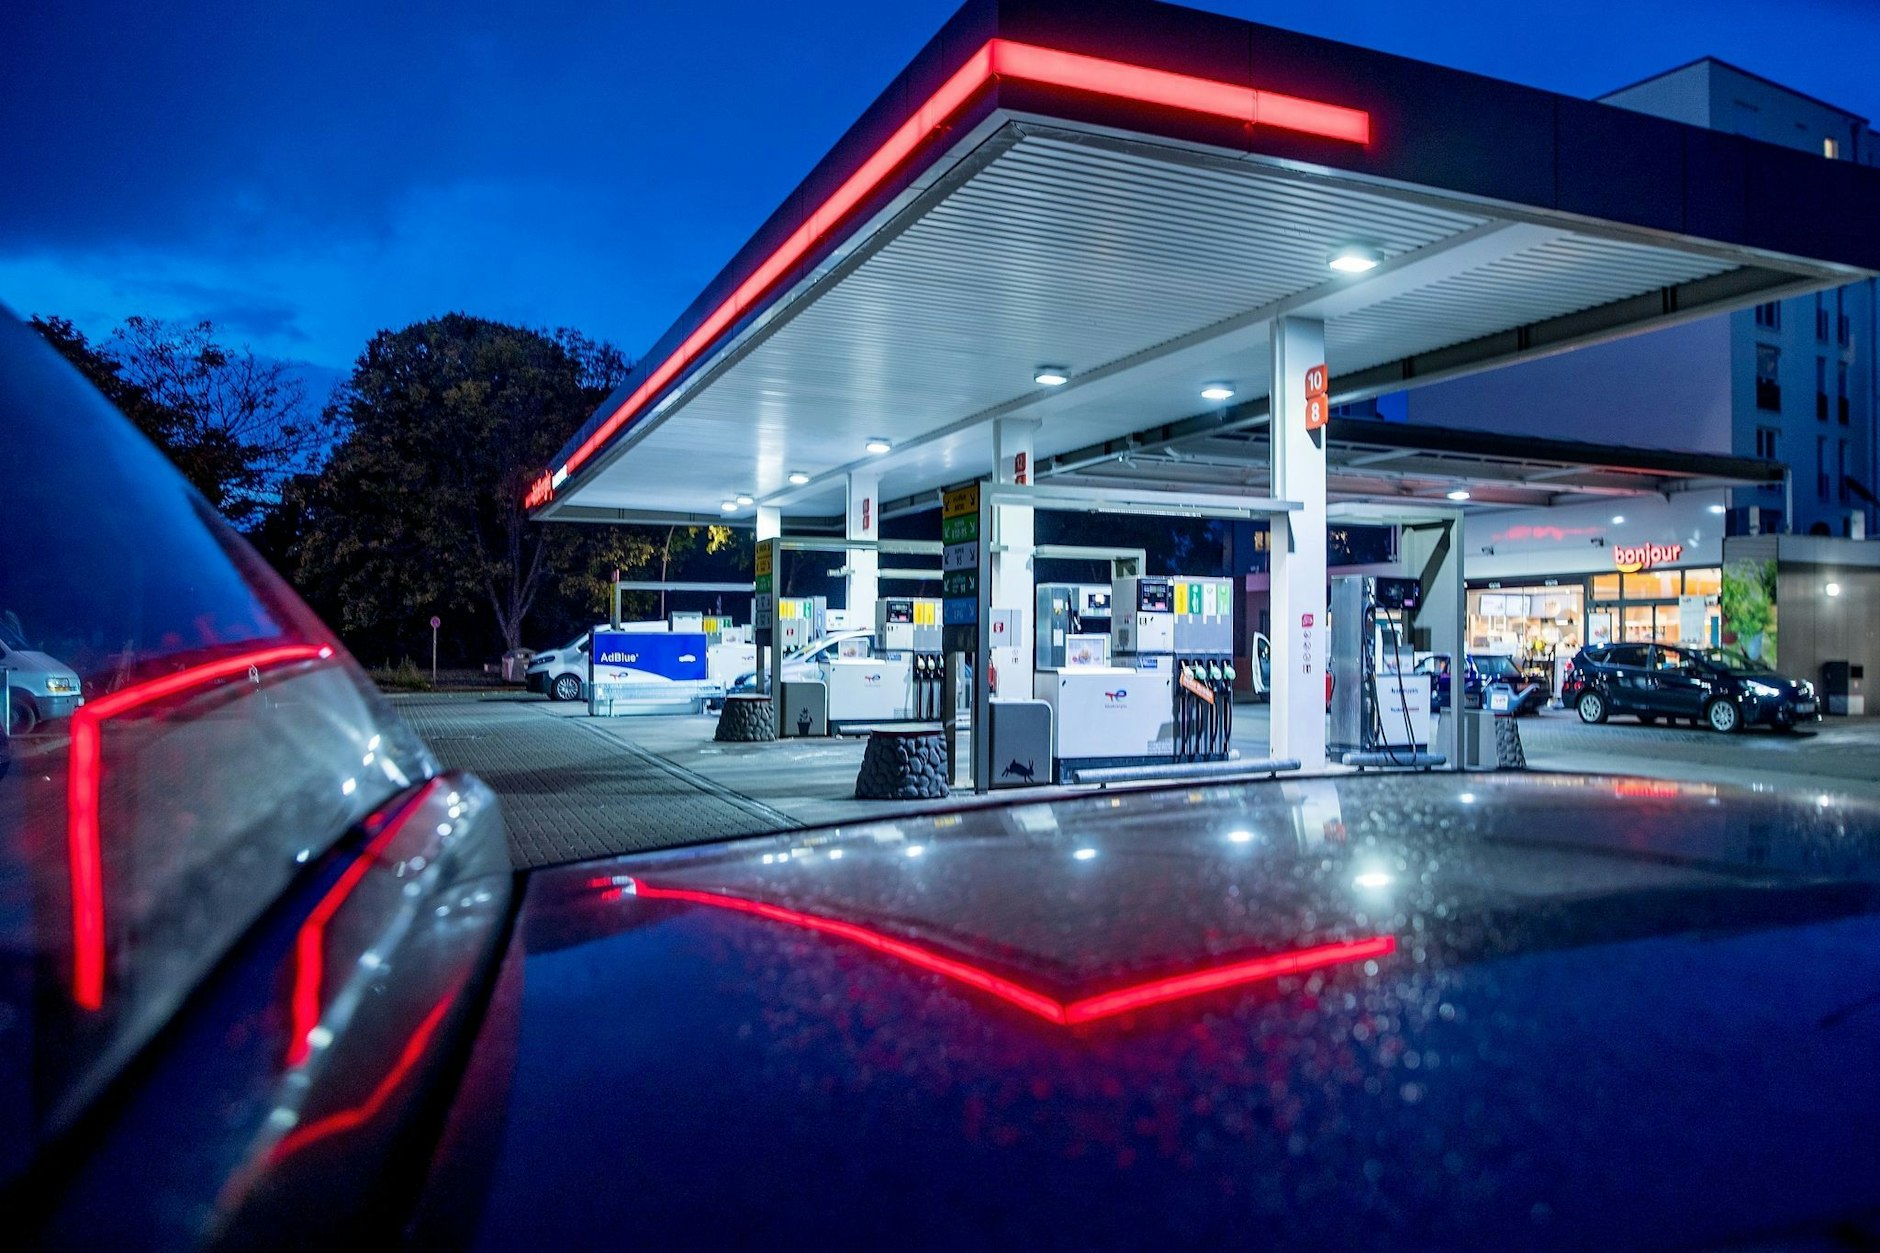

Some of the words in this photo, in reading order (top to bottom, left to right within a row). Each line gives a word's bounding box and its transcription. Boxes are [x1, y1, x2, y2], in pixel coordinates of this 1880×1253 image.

[1308, 371, 1322, 391] 10
[1312, 402, 1320, 422] 8
[1614, 542, 1683, 569] bonjour
